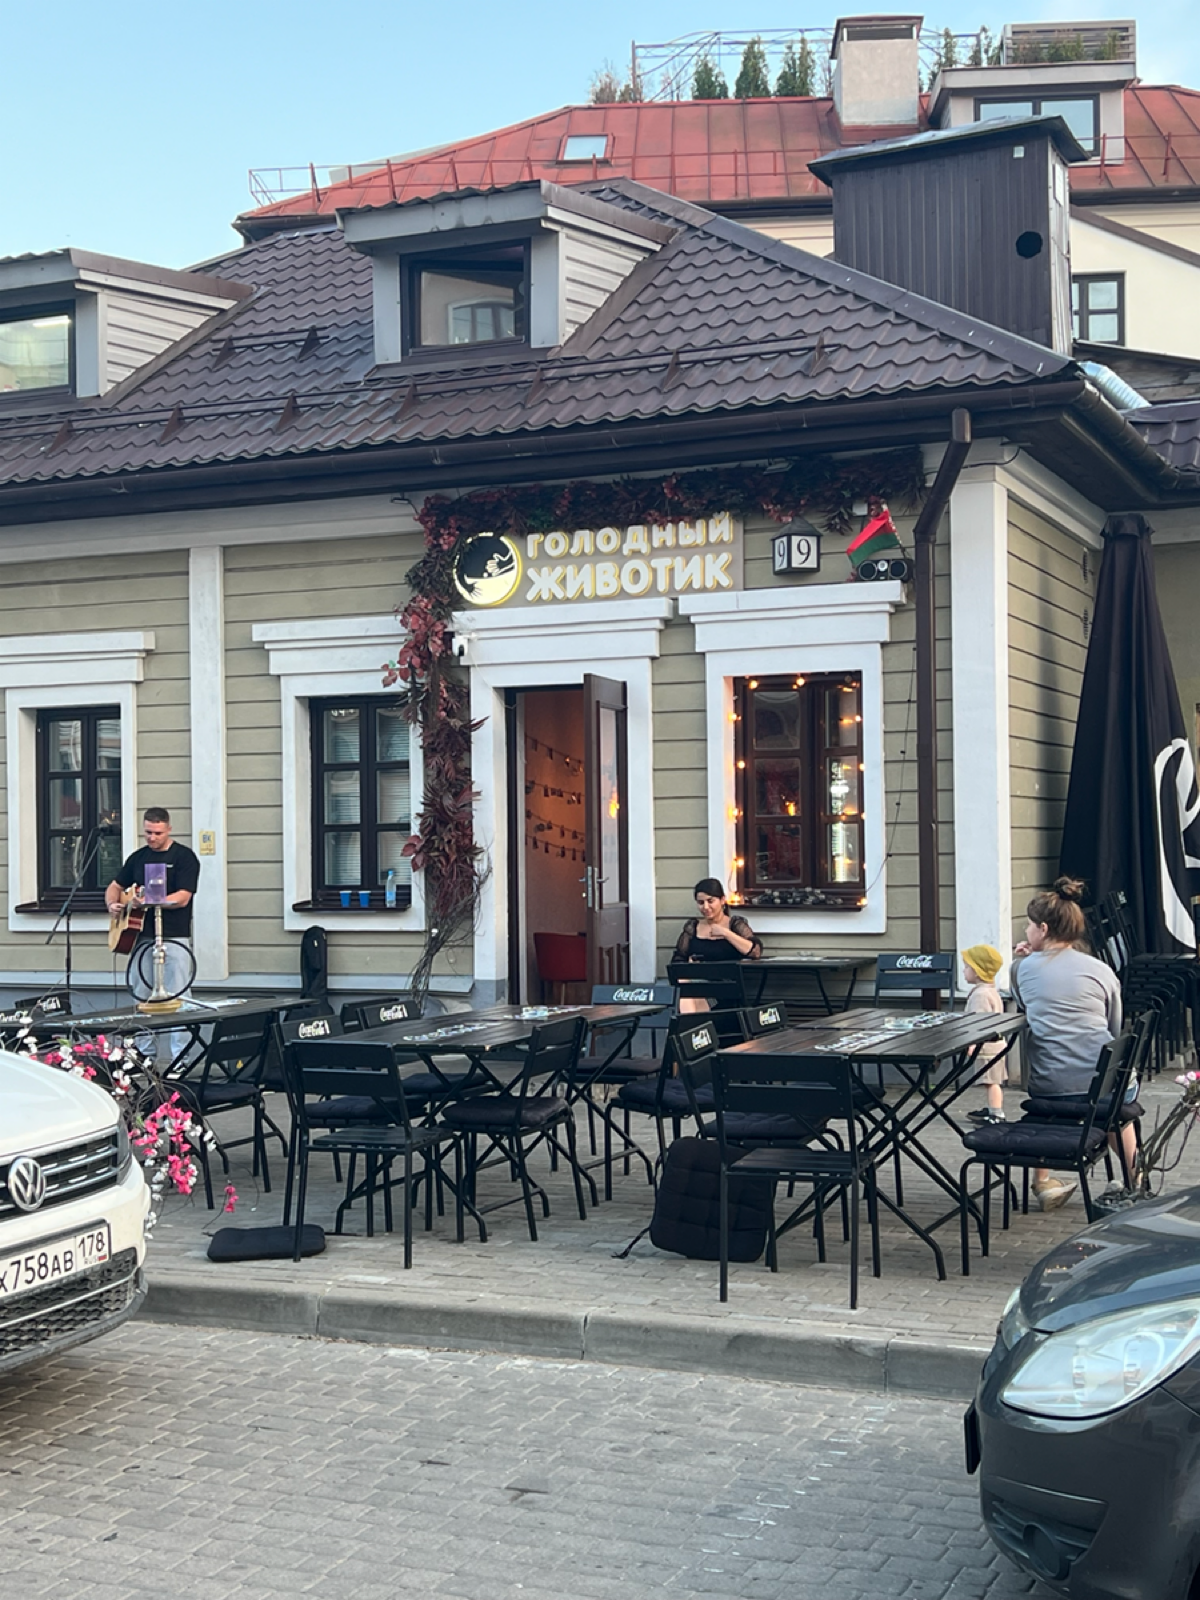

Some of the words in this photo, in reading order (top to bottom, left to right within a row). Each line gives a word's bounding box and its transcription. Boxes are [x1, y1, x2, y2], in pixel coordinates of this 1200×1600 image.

[526, 512, 733, 559] ГОЛОДНЫЙ
[778, 540, 785, 567] 9
[797, 538, 811, 565] 9
[526, 552, 733, 601] ЖИВОТИК
[78, 1231, 105, 1257] 178
